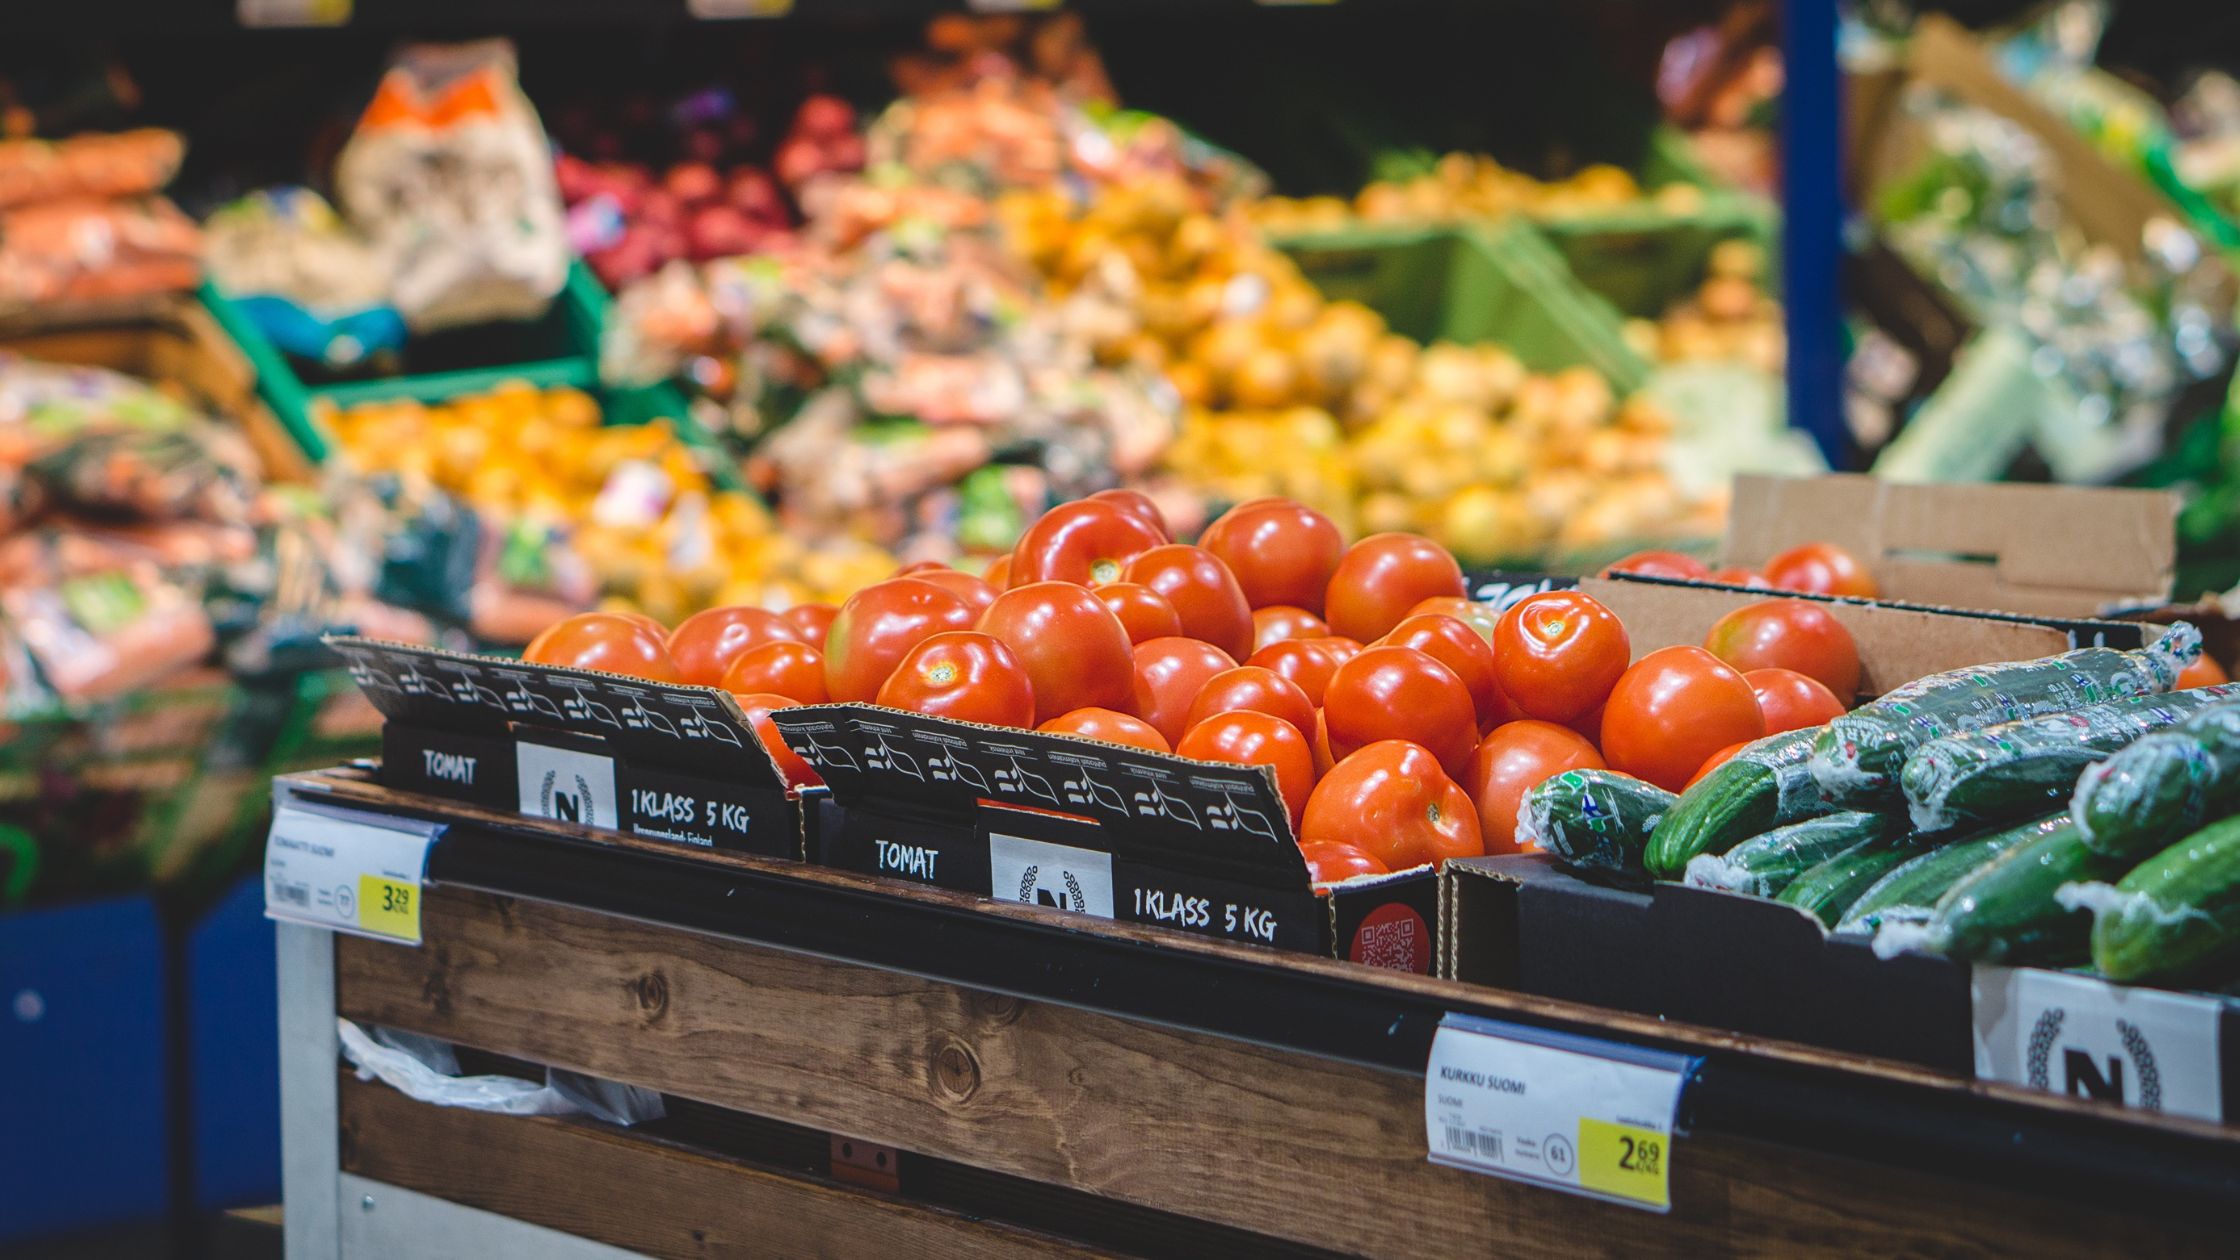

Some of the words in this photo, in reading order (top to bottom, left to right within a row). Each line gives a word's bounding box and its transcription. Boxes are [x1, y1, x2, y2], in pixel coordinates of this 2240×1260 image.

[422, 749, 477, 785] TOMAT
[640, 790, 695, 823] KLASS
[706, 800, 718, 827] 5
[721, 802, 750, 834] KG
[874, 838, 940, 880] TOMAT
[1143, 889, 1210, 928] KLASS
[1224, 904, 1238, 934] 5
[1243, 908, 1278, 942] KG
[1440, 1065, 1486, 1087] KURKKU
[1487, 1075, 1527, 1096] SUOMI
[2063, 1047, 2124, 1104] N
[1550, 1145, 1566, 1163] 61
